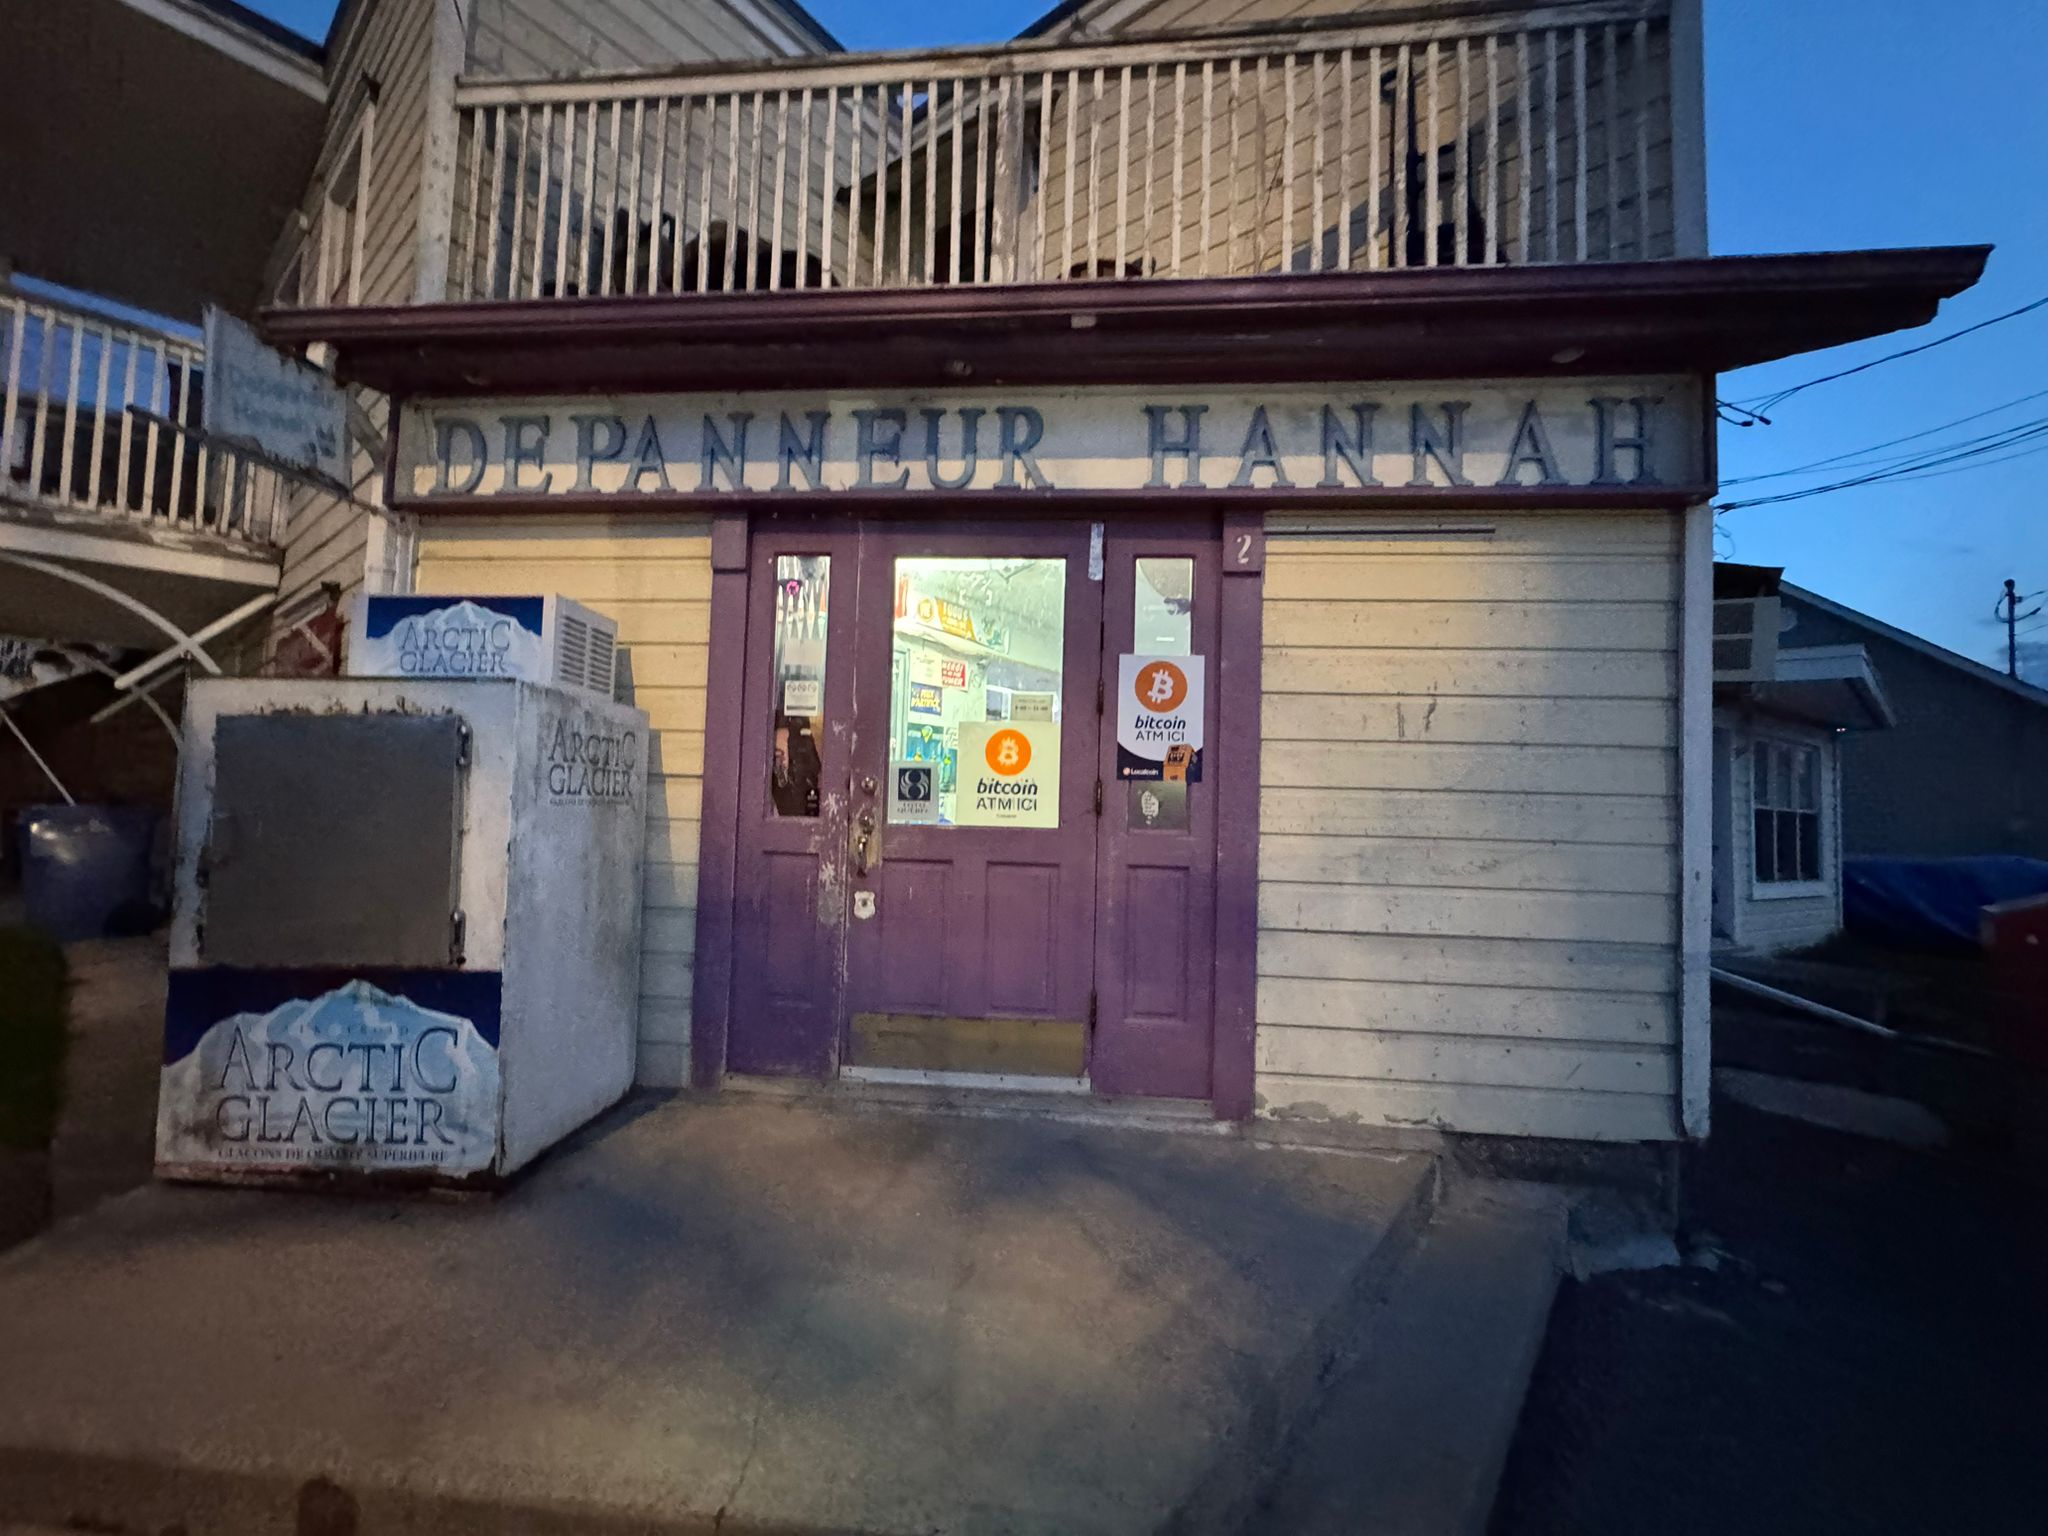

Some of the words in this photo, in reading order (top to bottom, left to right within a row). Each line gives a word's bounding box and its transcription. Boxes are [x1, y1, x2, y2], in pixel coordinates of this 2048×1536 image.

[430, 405, 1056, 496] DEPANNEUR
[1141, 396, 1665, 490] HANNAH
[1236, 534, 1252, 564] 2
[398, 619, 512, 652] ARCTIC
[399, 651, 509, 673] GLACIER
[1135, 714, 1186, 730] bitcoin
[1135, 731, 1164, 742] ATM
[1167, 731, 1185, 742] ICI
[547, 718, 636, 770] ARCTIC
[549, 764, 633, 797] GLACIER
[977, 777, 1038, 796] bitcoin
[976, 797, 1012, 811] ATM
[1017, 797, 1037, 812] ICI
[213, 1024, 459, 1094] ARCTIC
[215, 1095, 454, 1145] GLACIER
